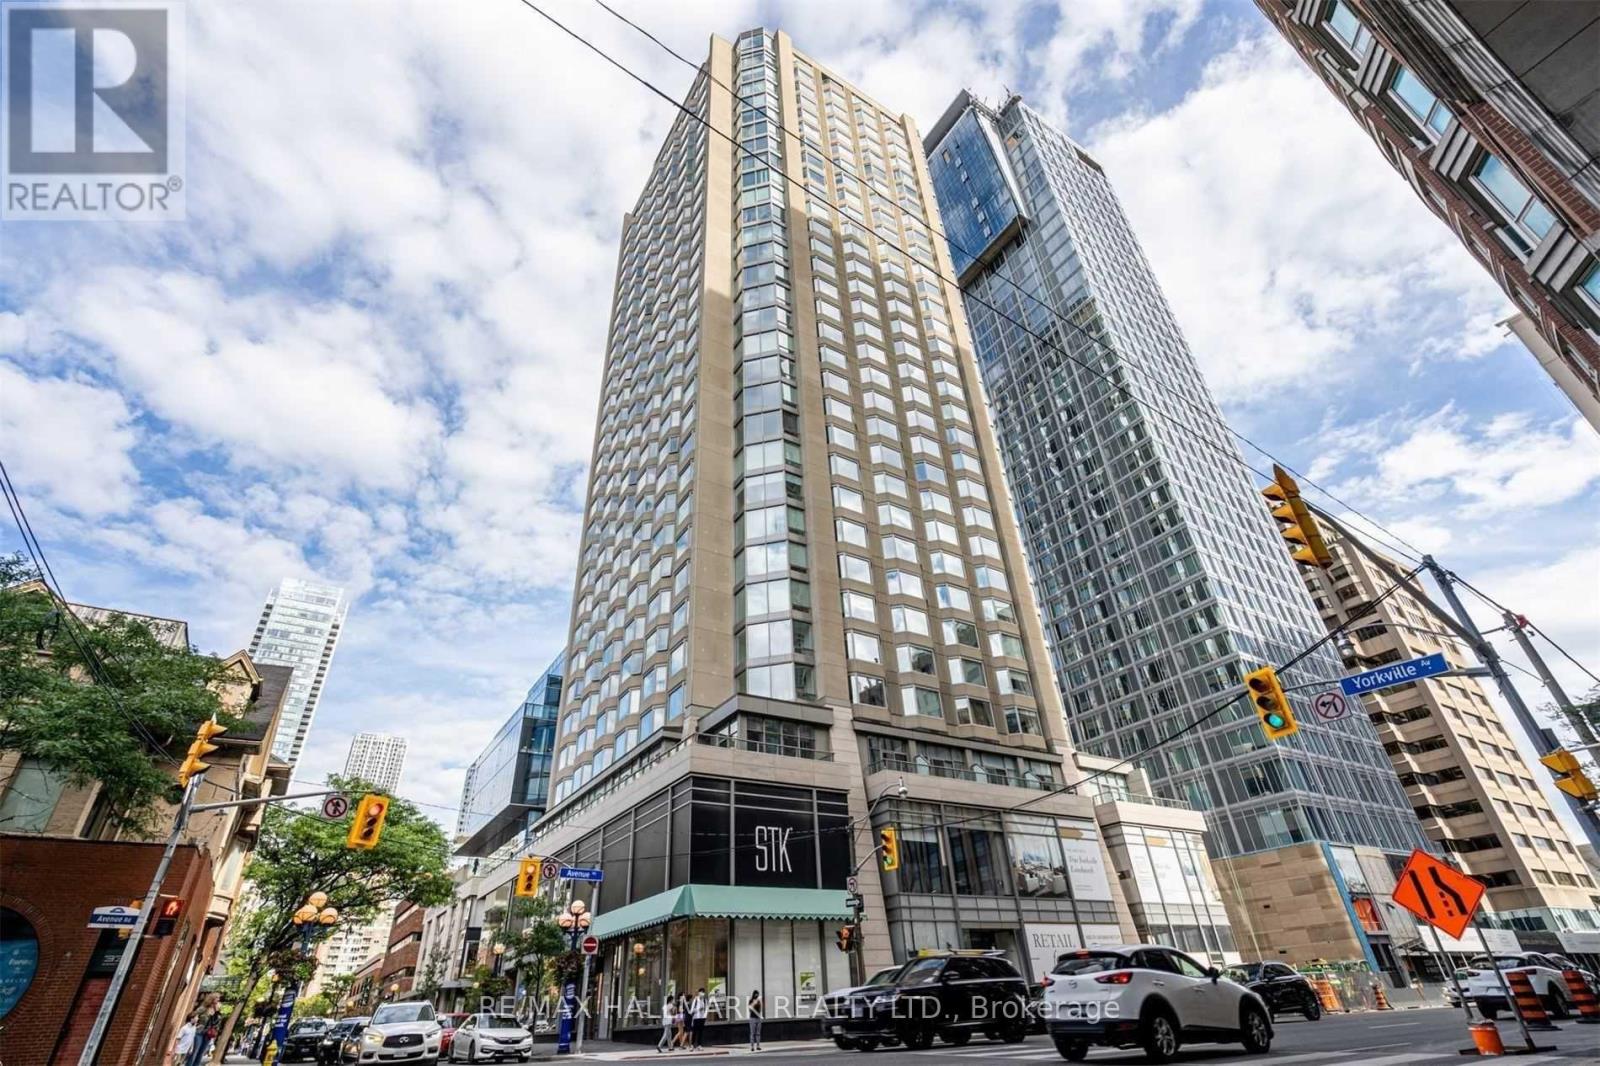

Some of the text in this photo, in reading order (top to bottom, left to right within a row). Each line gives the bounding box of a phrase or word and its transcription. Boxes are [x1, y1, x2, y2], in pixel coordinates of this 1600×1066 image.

[1351, 665, 1417, 689] Yorkville
[755, 825, 793, 872] STK
[567, 870, 590, 878] Avenue
[96, 915, 122, 923] Avenue
[1032, 933, 1077, 949] RETAIL
